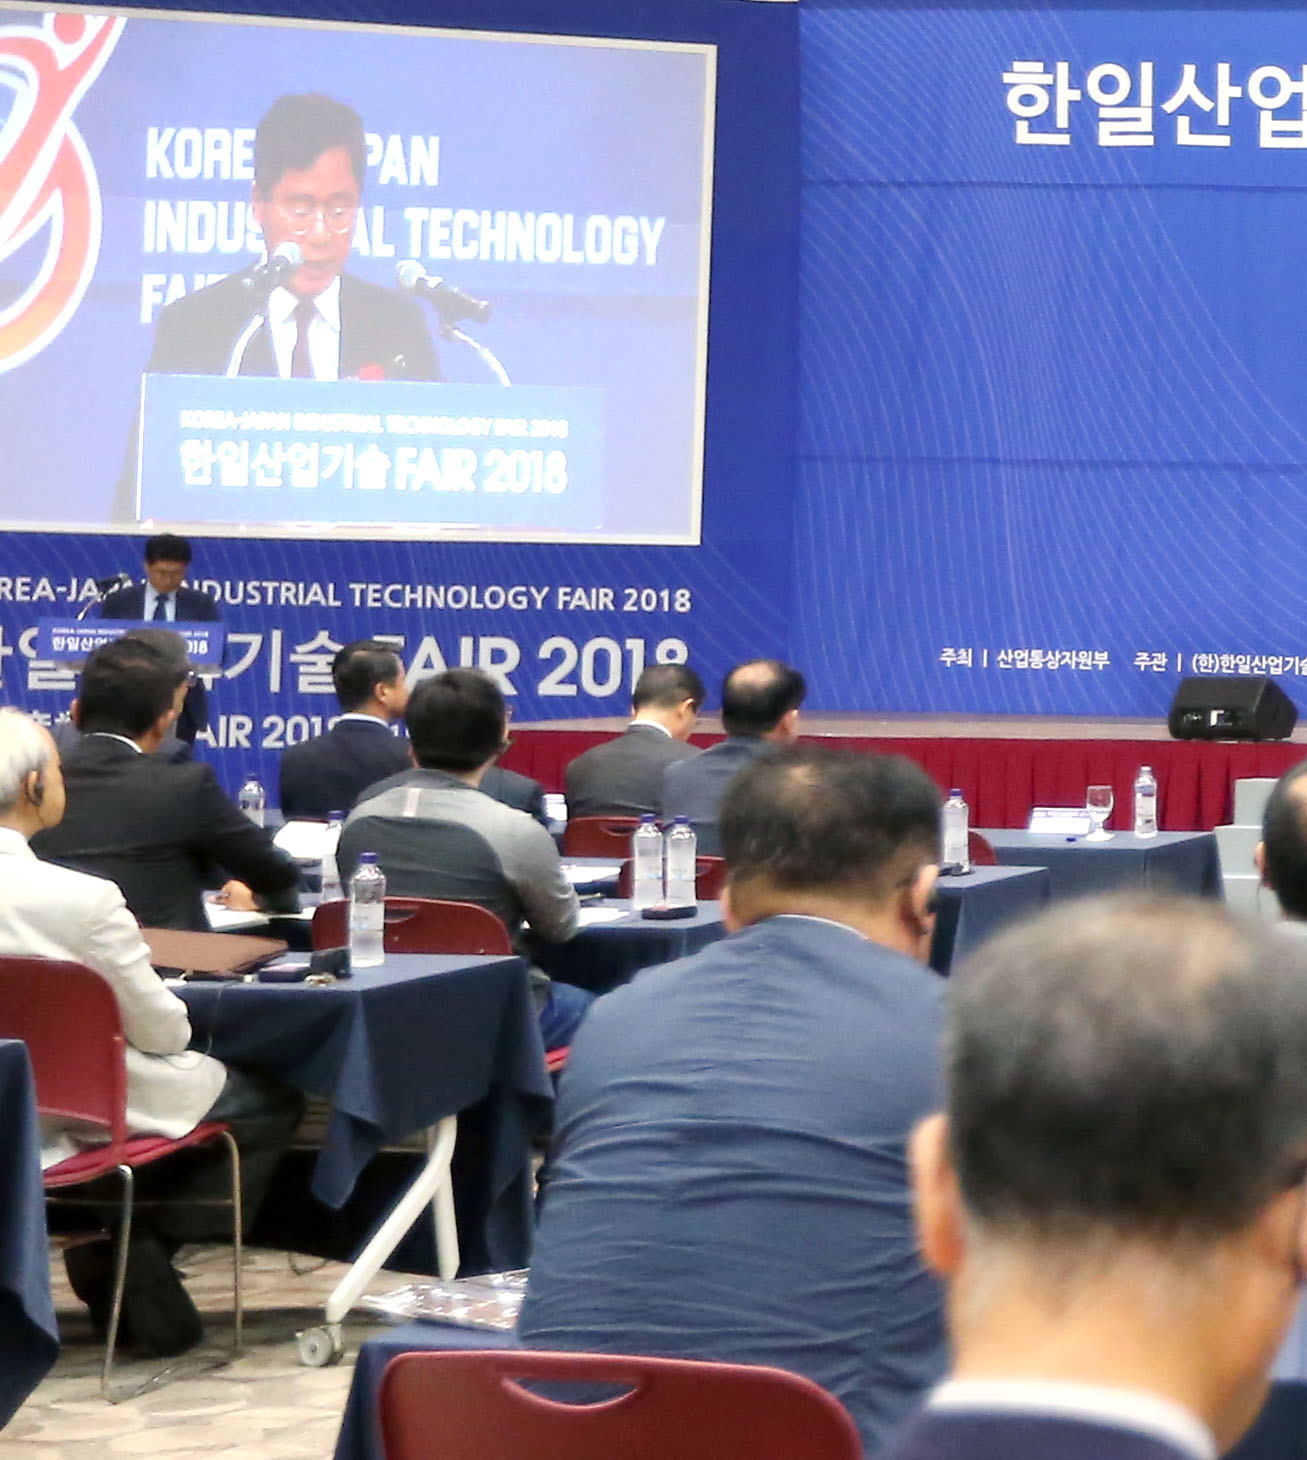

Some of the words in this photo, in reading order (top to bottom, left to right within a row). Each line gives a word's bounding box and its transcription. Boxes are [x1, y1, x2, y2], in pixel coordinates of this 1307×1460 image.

[404, 207, 665, 265] TECHNOLOGY
[180, 439, 392, 490] 한일산업기술
[395, 446, 479, 493] FAIR
[482, 448, 569, 494] 2018
[349, 583, 549, 611] TECHNOLOGY
[557, 586, 615, 611] FAIR
[623, 588, 692, 613] 2018
[940, 647, 973, 668] 주최
[997, 649, 1111, 671] 산업통상자원부
[1134, 652, 1169, 672] 주관
